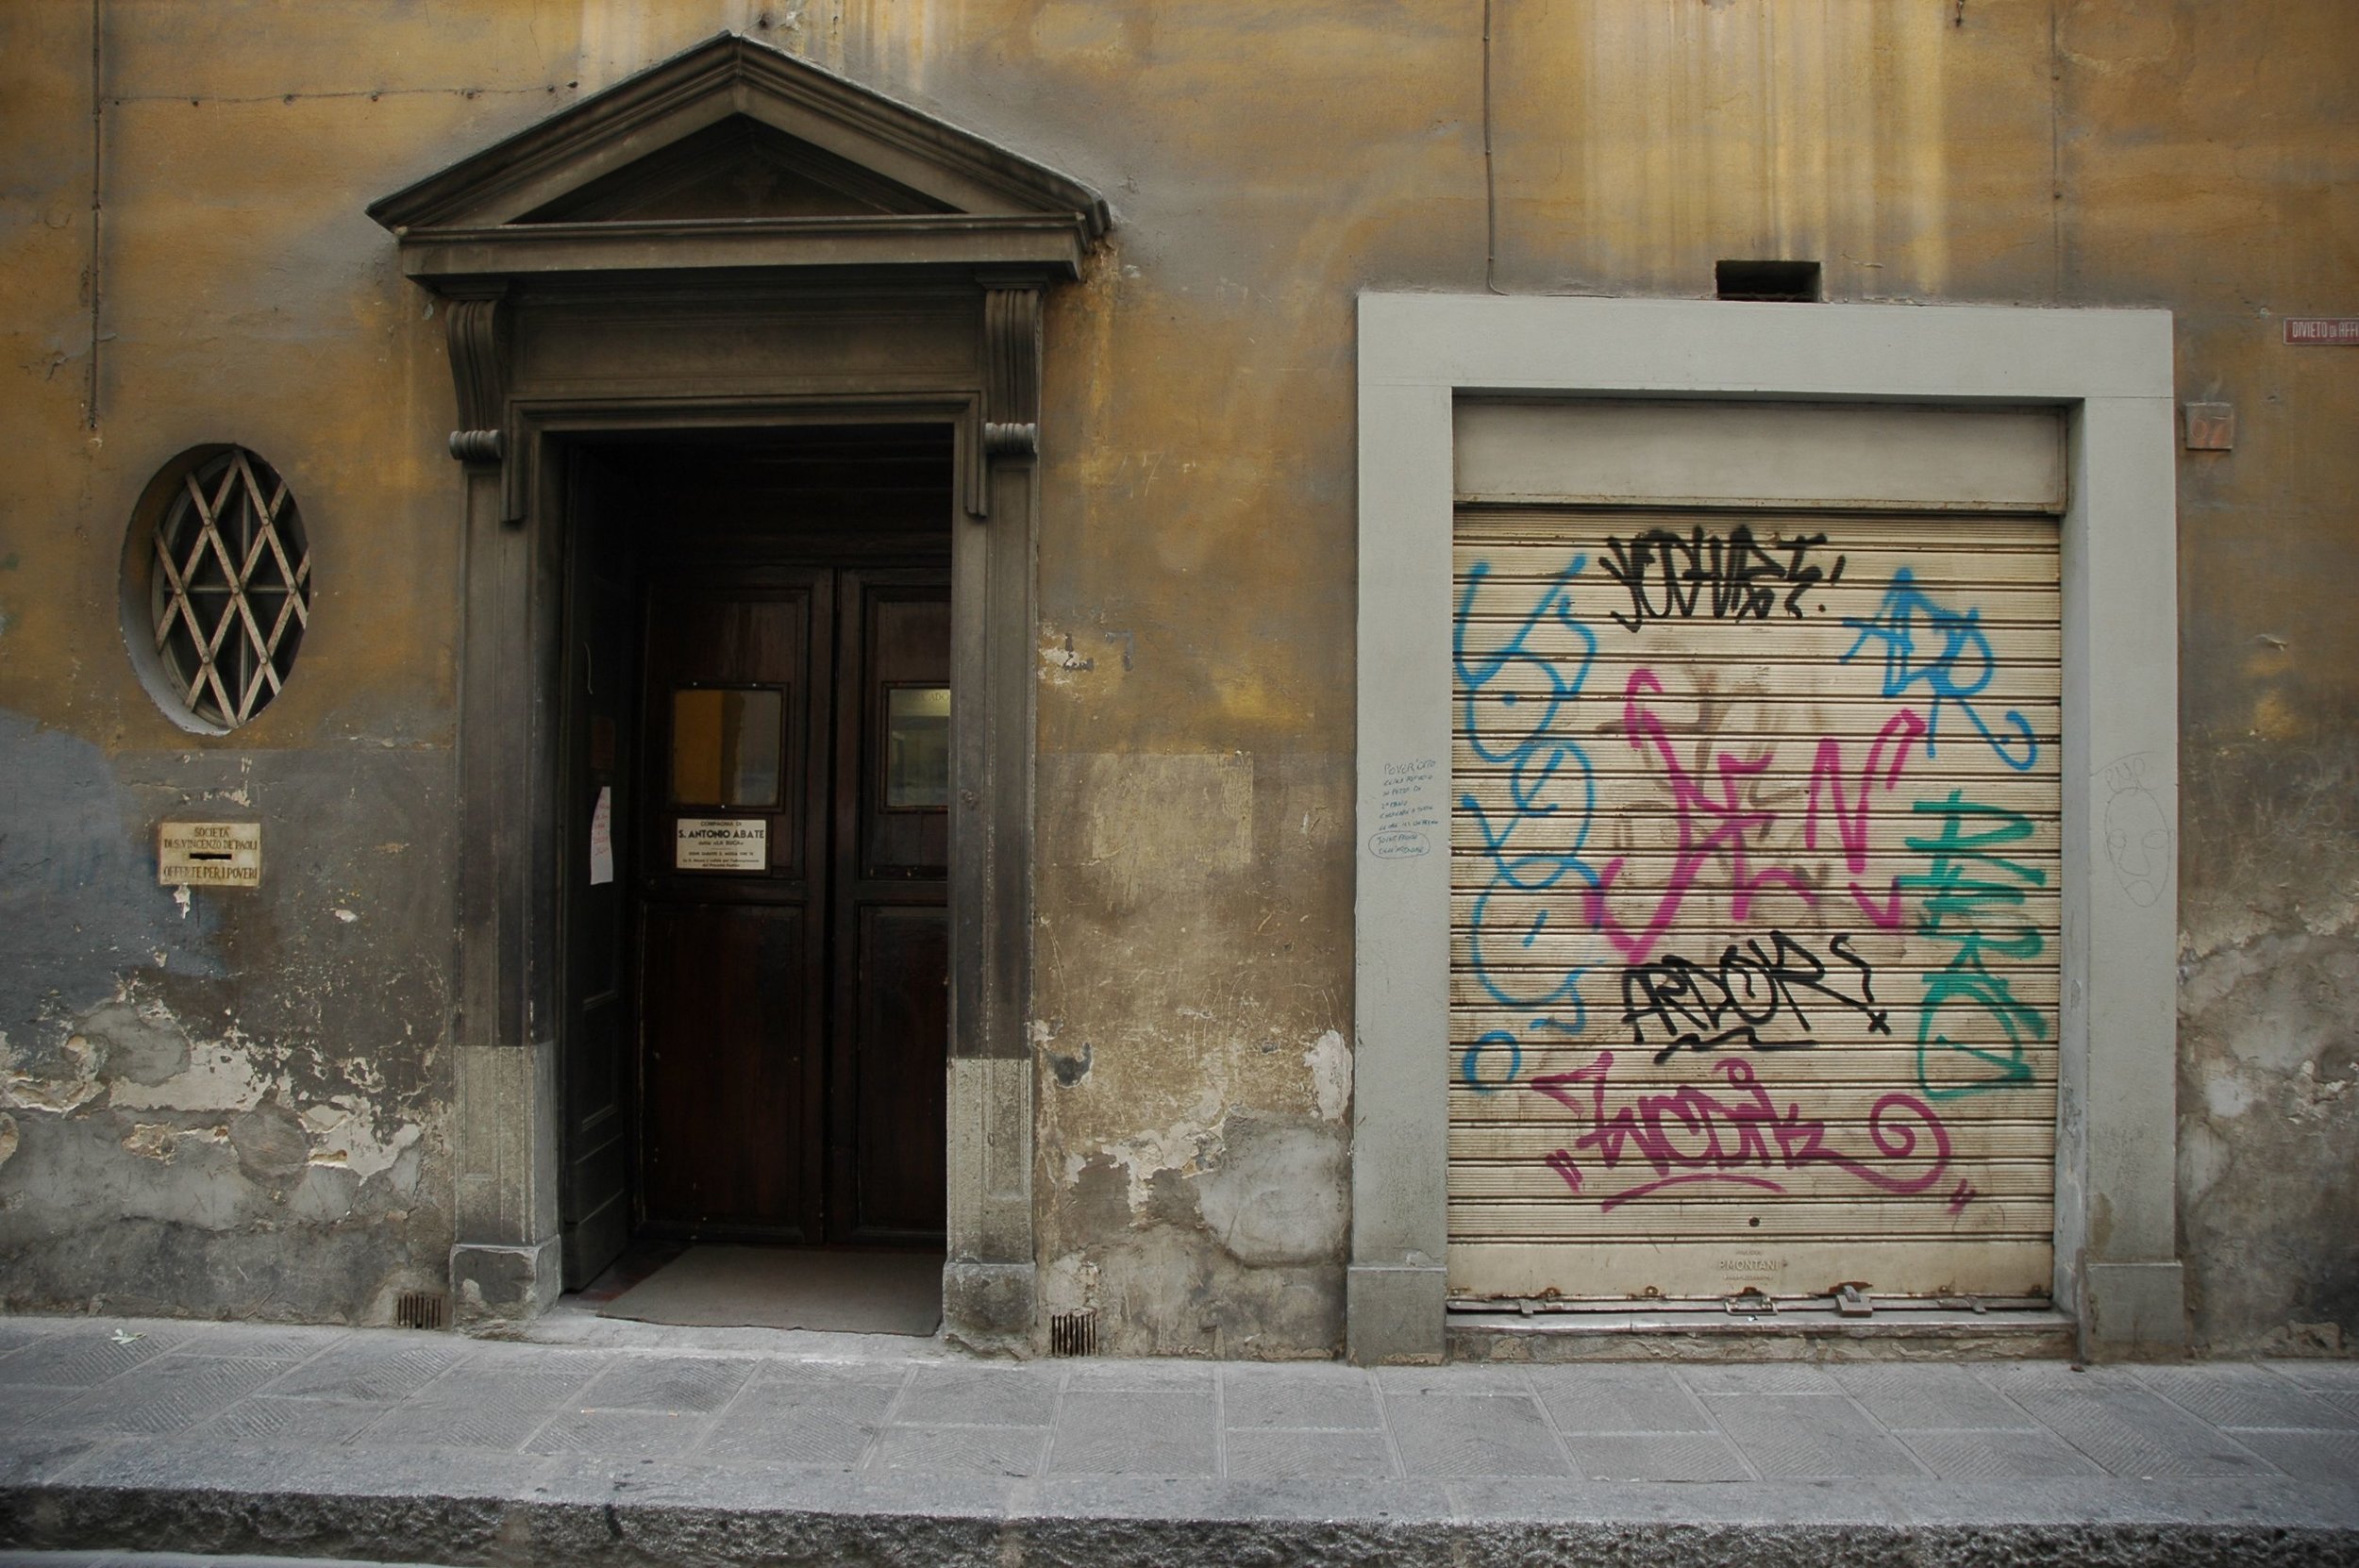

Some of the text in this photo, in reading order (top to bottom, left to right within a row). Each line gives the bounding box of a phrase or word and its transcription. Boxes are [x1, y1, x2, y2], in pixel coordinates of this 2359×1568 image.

[2292, 321, 2328, 338] DIVIETO
[688, 829, 730, 839] ANTONIO
[732, 829, 764, 839] ABATE
[203, 866, 221, 880] PER
[226, 866, 258, 879] POVERI
